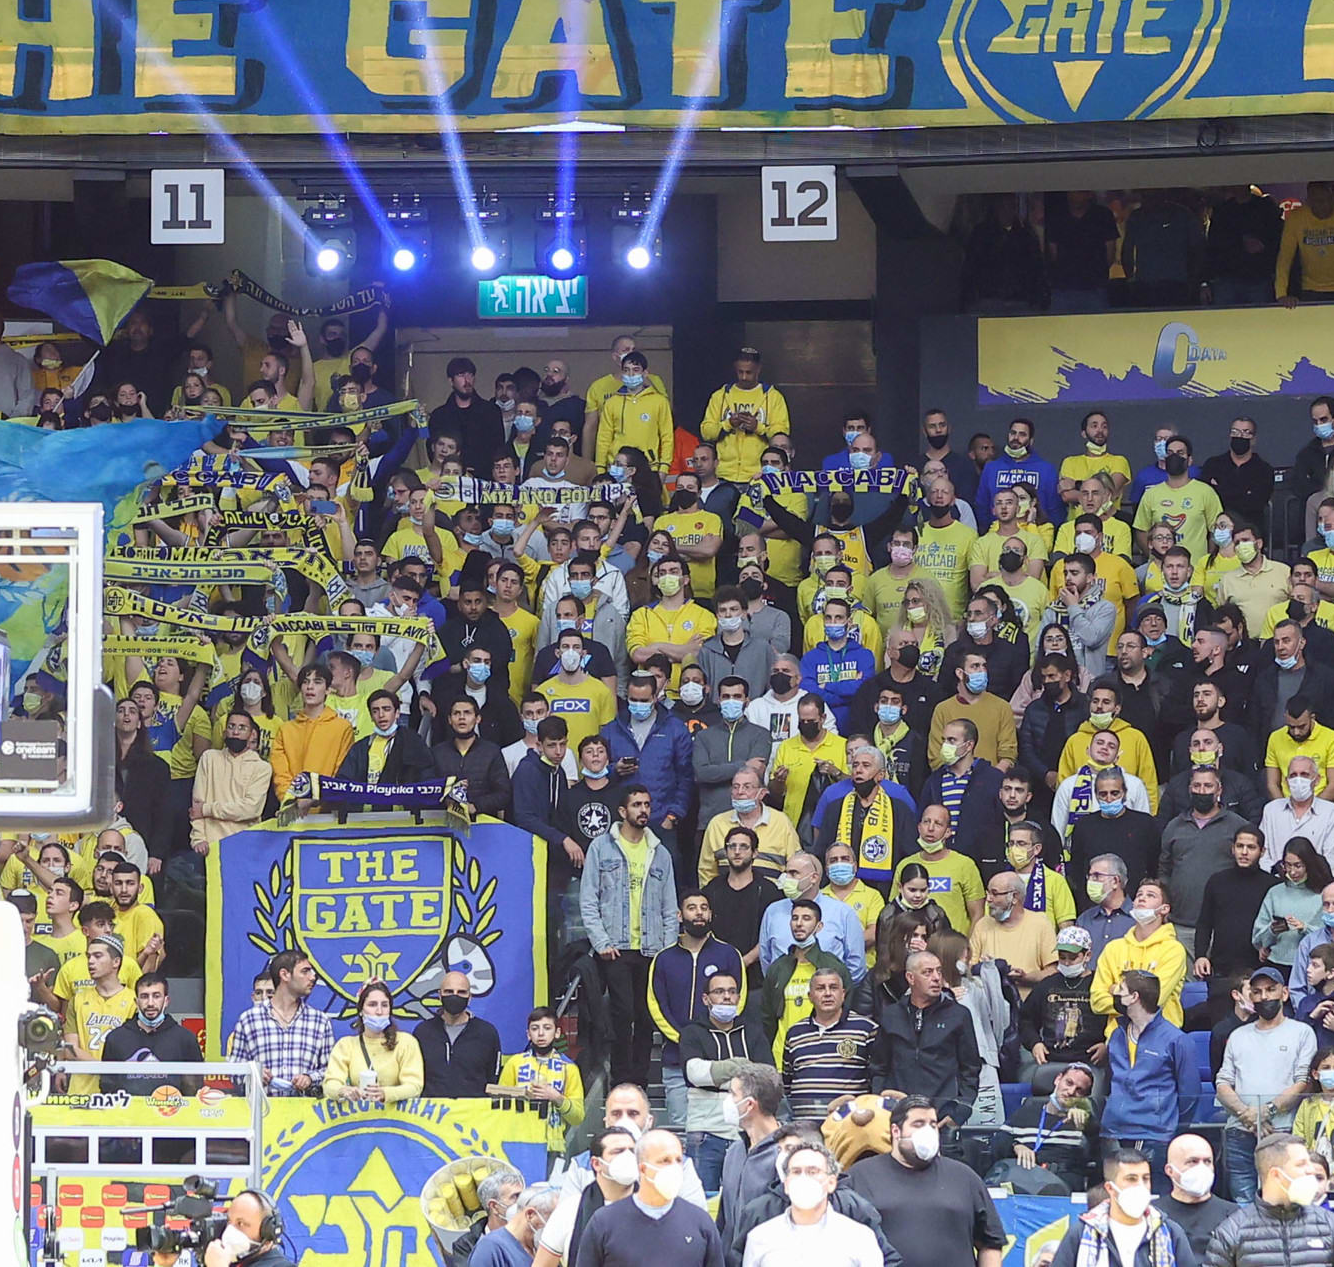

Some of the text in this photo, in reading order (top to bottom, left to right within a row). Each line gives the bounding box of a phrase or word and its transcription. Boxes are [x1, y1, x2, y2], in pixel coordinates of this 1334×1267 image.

[162, 183, 212, 229] 11
[770, 180, 829, 227] 12
[515, 276, 580, 315] יציאה
[1186, 346, 1227, 362] DATA
[766, 469, 907, 494] MACCABI
[998, 473, 1036, 485] MACCABI
[481, 486, 603, 504] MILANO 2014
[913, 554, 958, 569] MACCABI
[131, 566, 245, 579] מכבי תל-אביב
[273, 621, 429, 640] MACCABI TEL AVIV
[553, 700, 587, 711] FOX
[15, 745, 56, 755] oneteam
[322, 780, 442, 797] מכבי Playtika תל אביב
[319, 848, 419, 883] THE
[305, 891, 441, 932] GATE
[86, 1012, 123, 1026] LAKERS
[92, 1090, 130, 1108] ליגת
